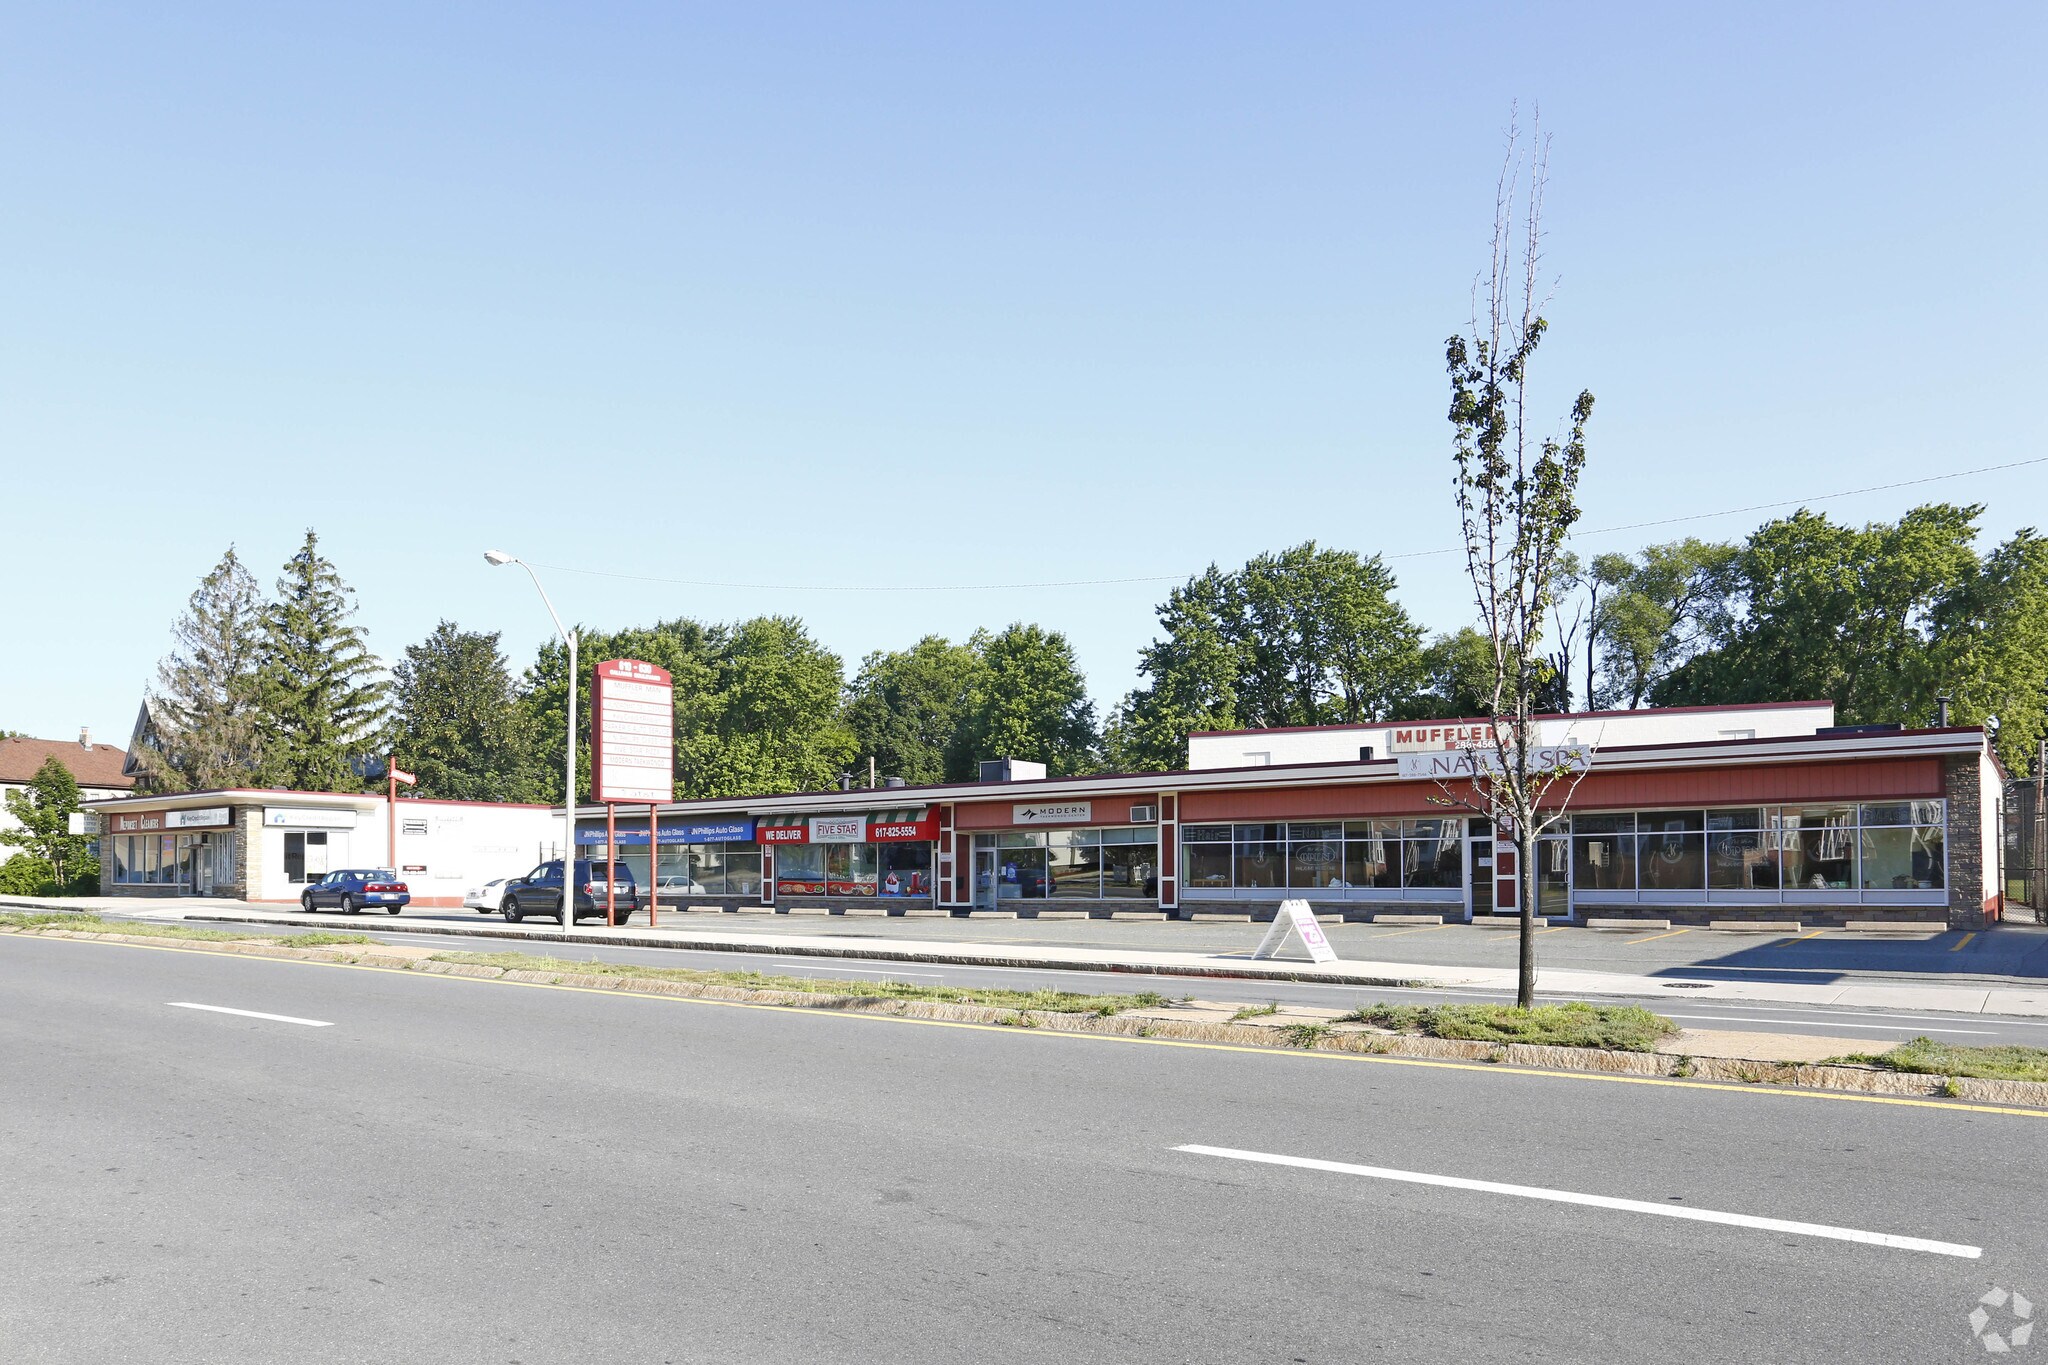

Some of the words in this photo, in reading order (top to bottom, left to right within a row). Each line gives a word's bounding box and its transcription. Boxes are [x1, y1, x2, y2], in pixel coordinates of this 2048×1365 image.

[1040, 807, 1086, 815] MODERN
[715, 825, 729, 834] Auto
[729, 824, 744, 833] Glass
[765, 830, 776, 840] WE
[776, 829, 802, 840] DELIVER
[818, 824, 835, 835] FIVE
[837, 823, 857, 834] STAR
[875, 826, 917, 838] 617-825-5554
